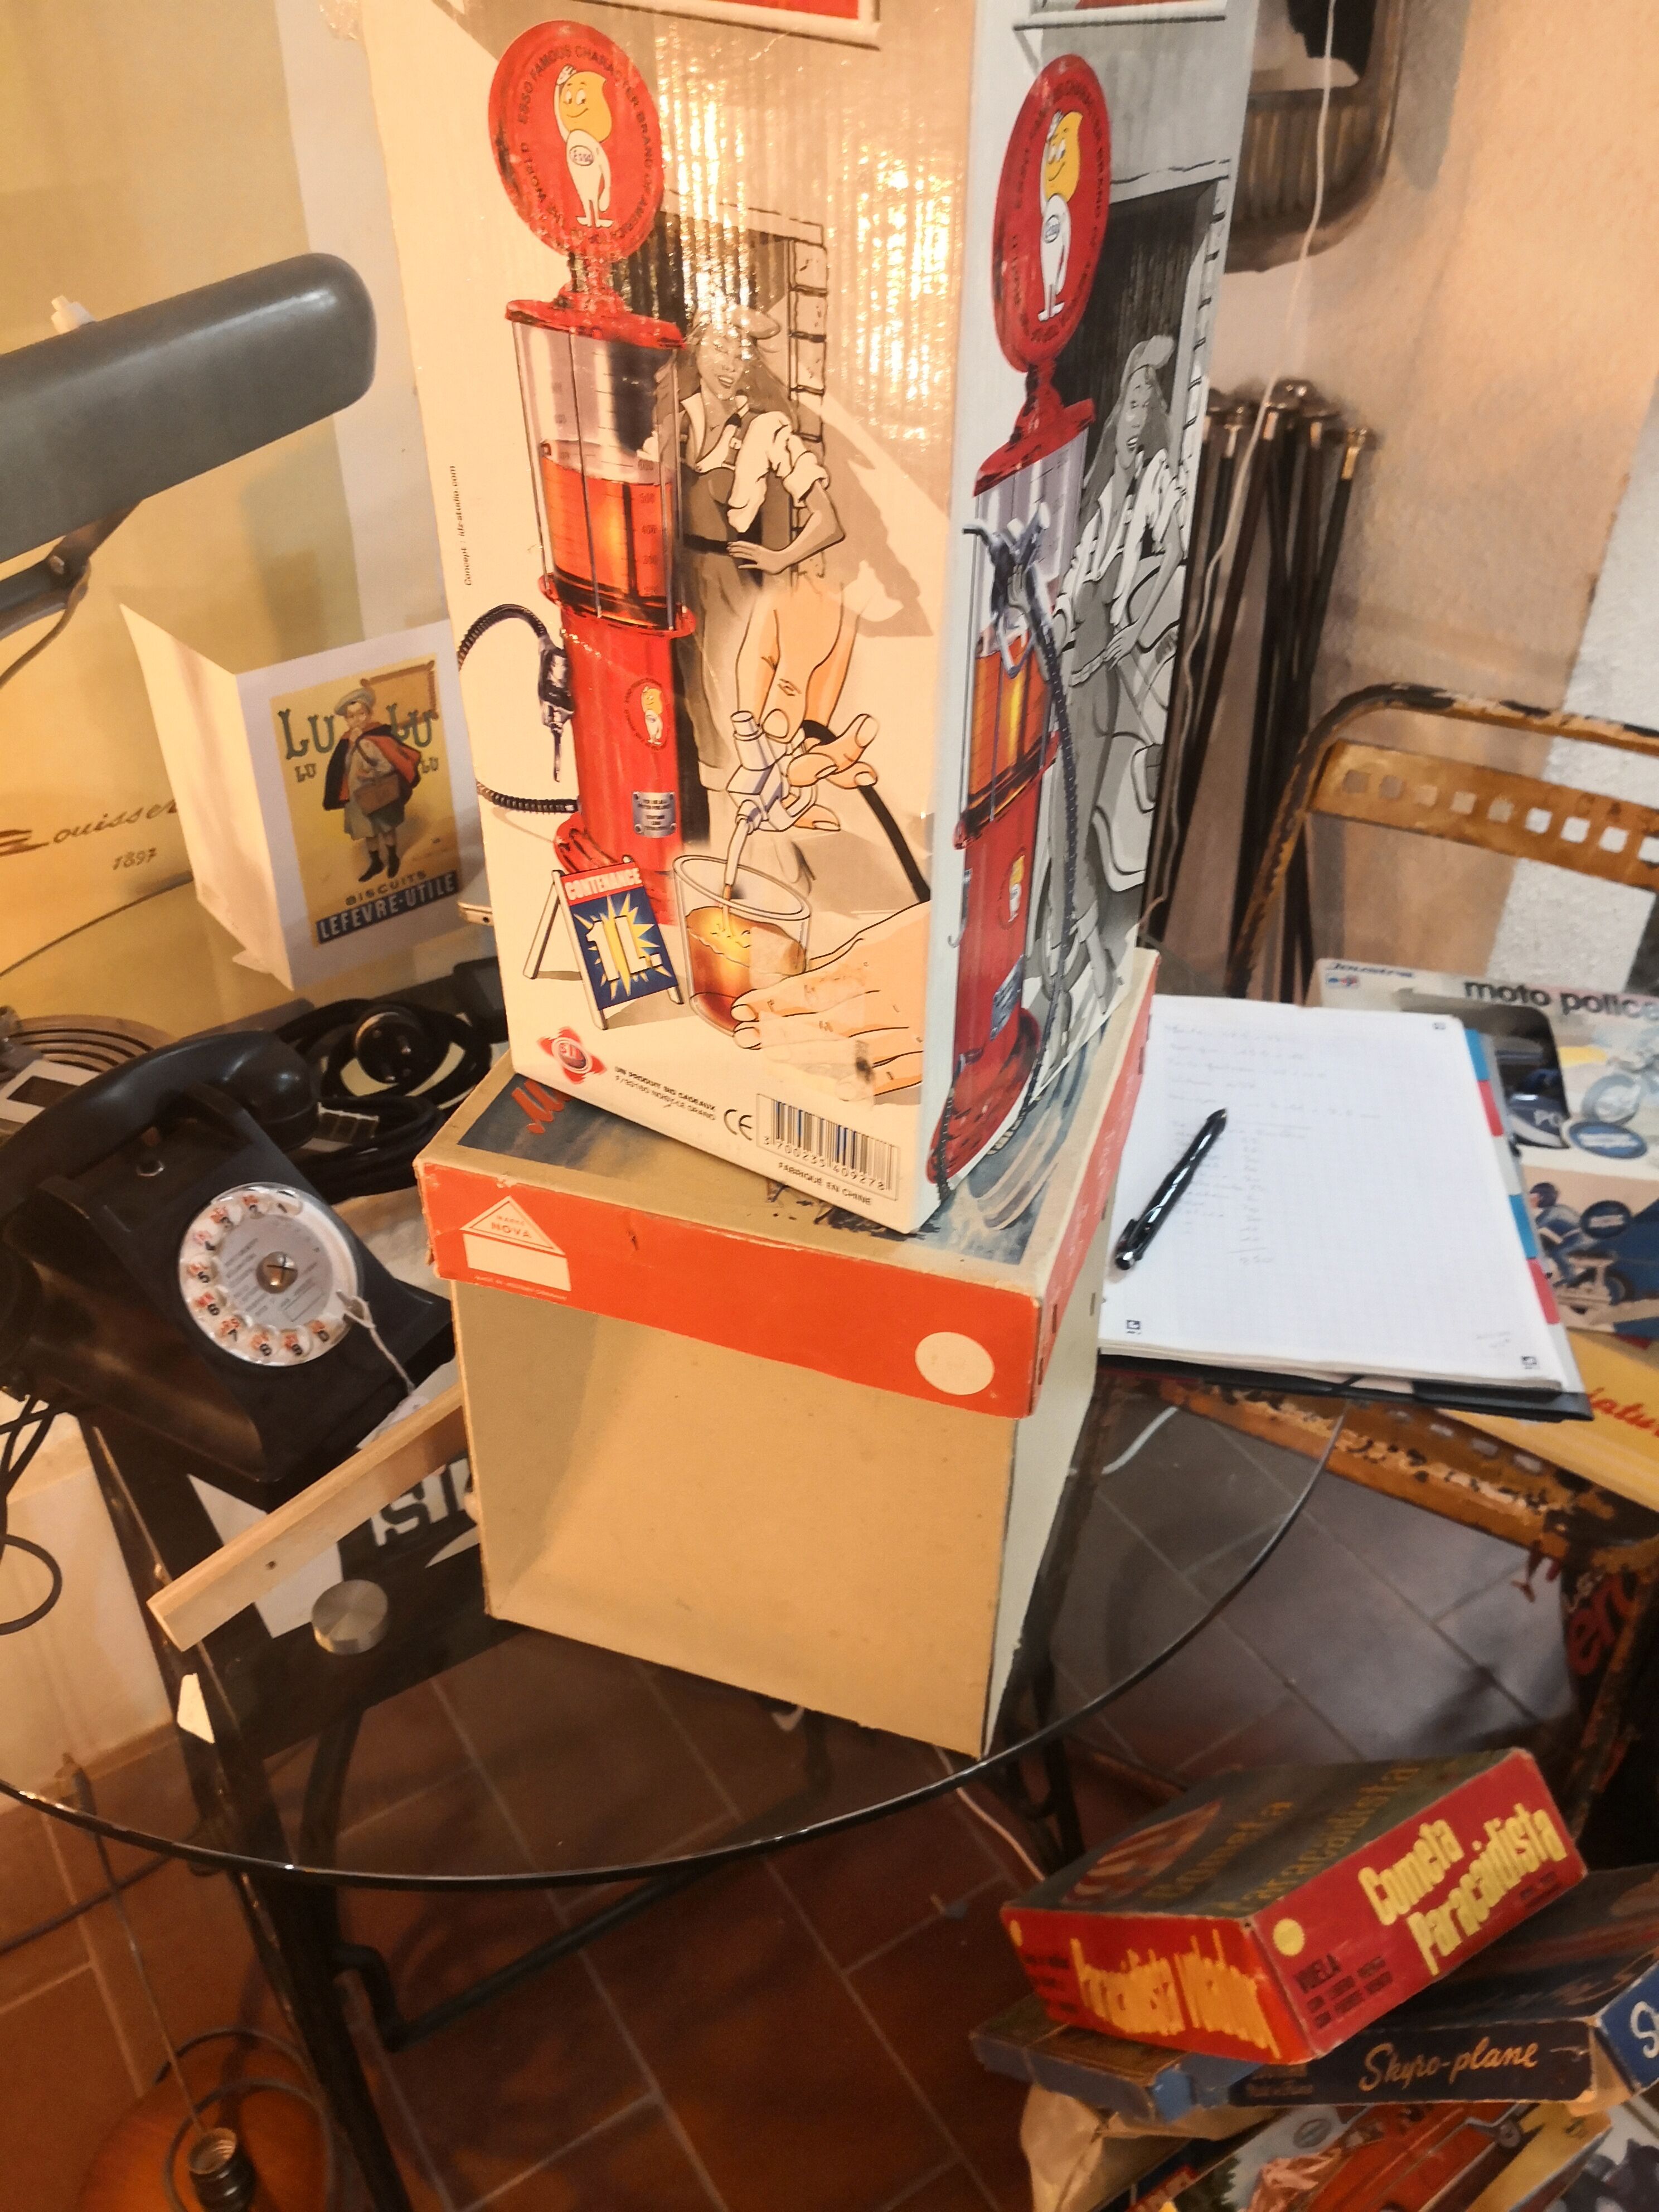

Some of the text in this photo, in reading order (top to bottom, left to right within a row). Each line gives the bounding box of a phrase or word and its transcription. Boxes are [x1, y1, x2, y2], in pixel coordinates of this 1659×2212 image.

[460, 548, 472, 586] Concept
[278, 708, 334, 760] LU
[564, 867, 643, 901] CONTENANCE
[1463, 981, 1552, 1006] moto
[826, 1181, 839, 1193] EN
[842, 1187, 872, 1206] CHINE
[491, 1222, 532, 1239] NOVA
[1358, 1818, 1464, 1926] Cometa
